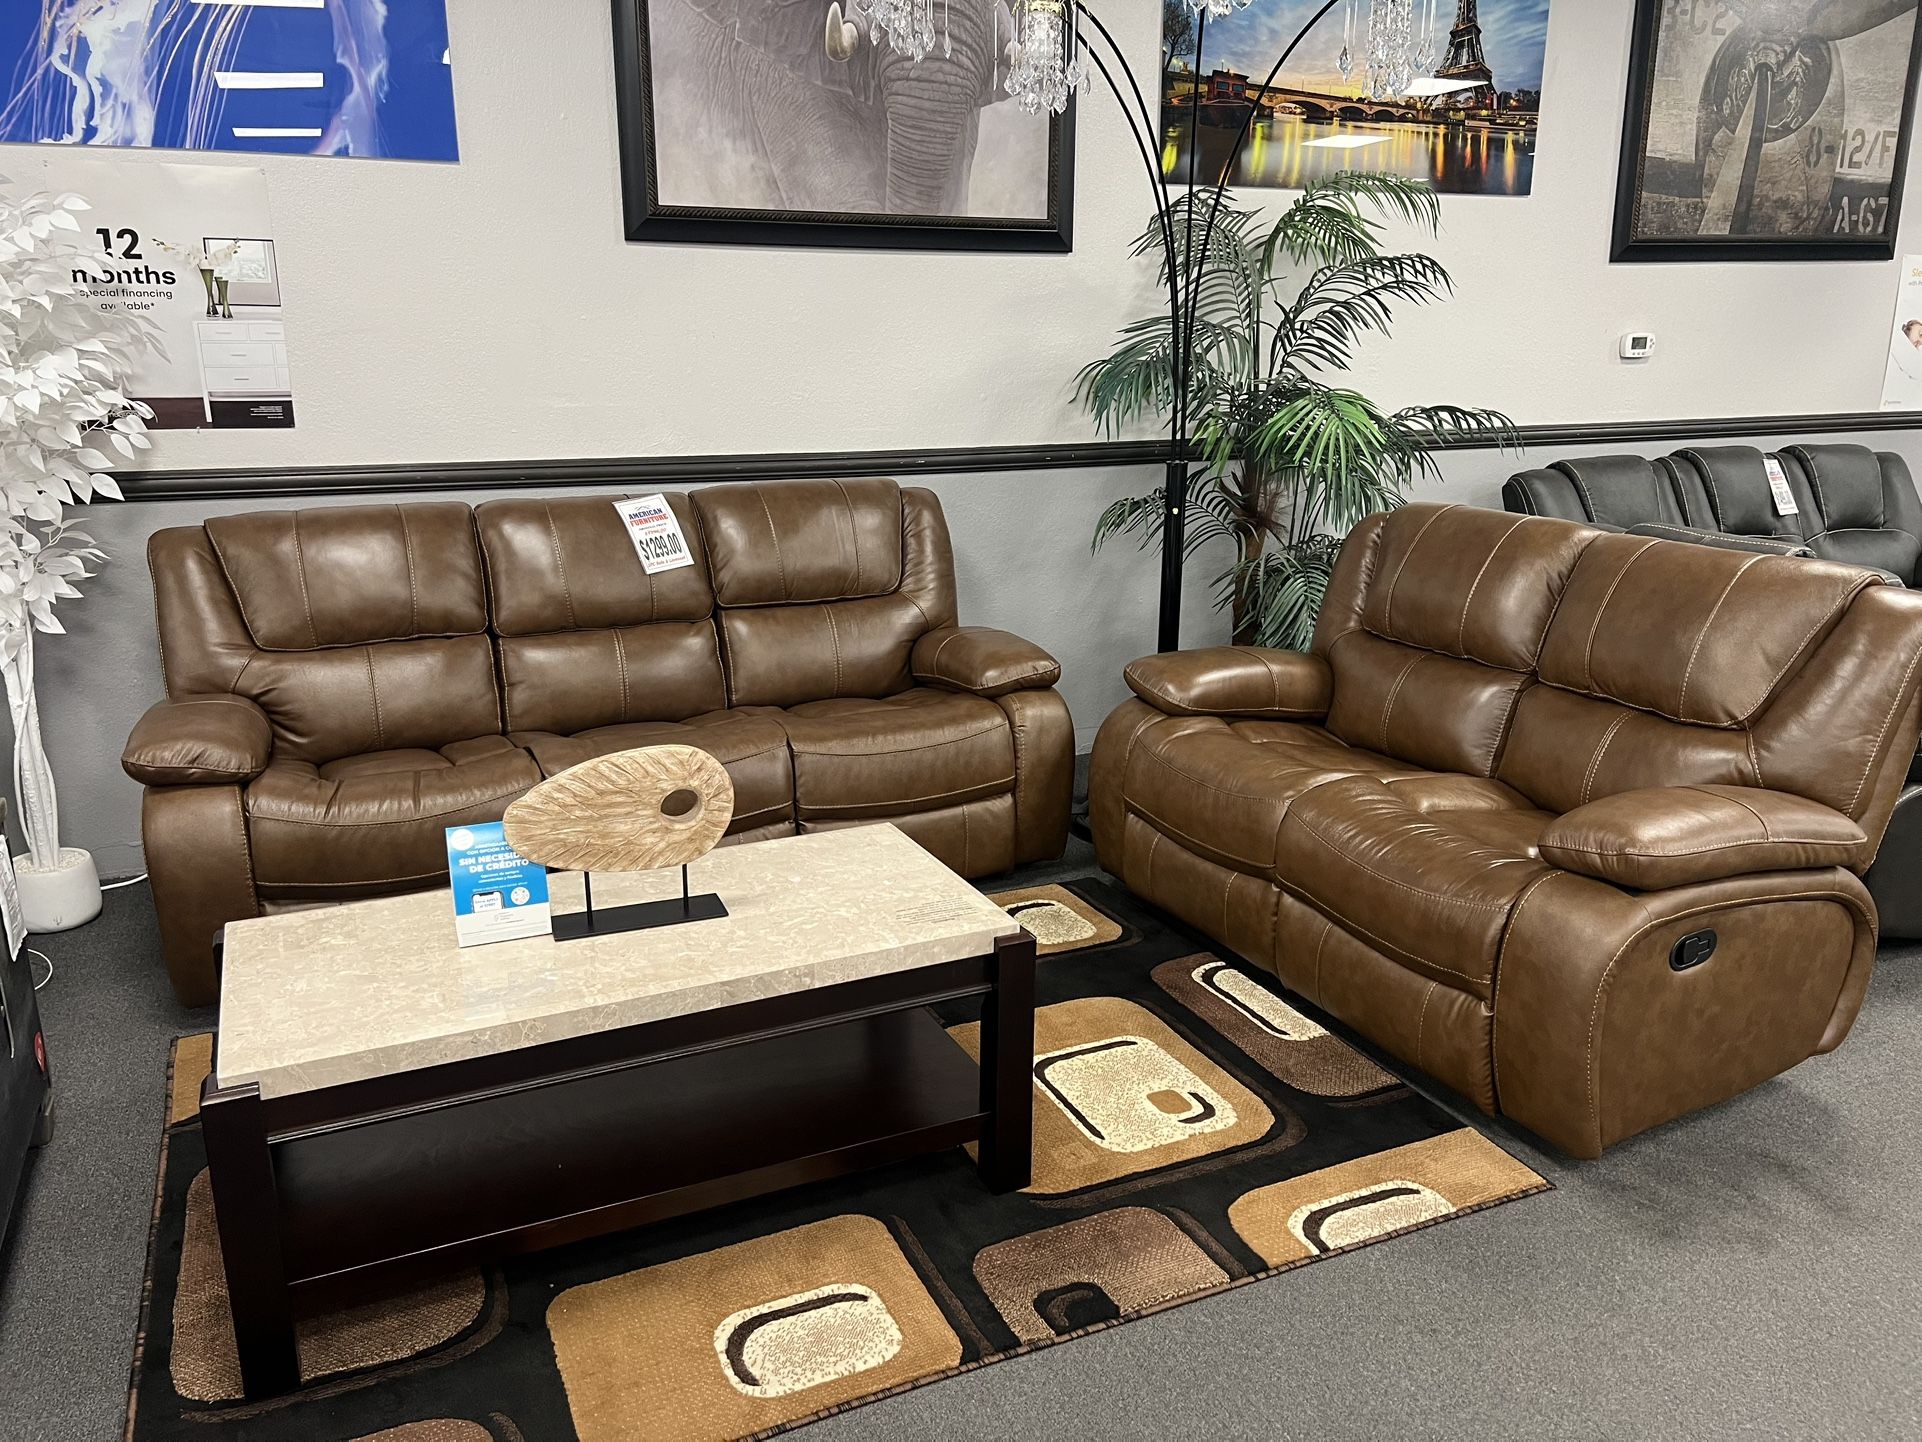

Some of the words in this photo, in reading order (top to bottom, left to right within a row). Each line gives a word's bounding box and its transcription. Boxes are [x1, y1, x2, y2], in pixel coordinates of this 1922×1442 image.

[1833, 196, 1889, 234] A-67
[96, 228, 143, 260] 12
[72, 265, 177, 285] months
[122, 289, 173, 300] financing
[629, 508, 663, 520] AMERICAN
[630, 514, 669, 527] FURNITURE
[640, 533, 682, 560] $1299.00
[459, 856, 476, 866] SIN
[478, 852, 521, 863] NECESID
[469, 864, 484, 874] DE
[486, 858, 530, 871] CRÉDITO
